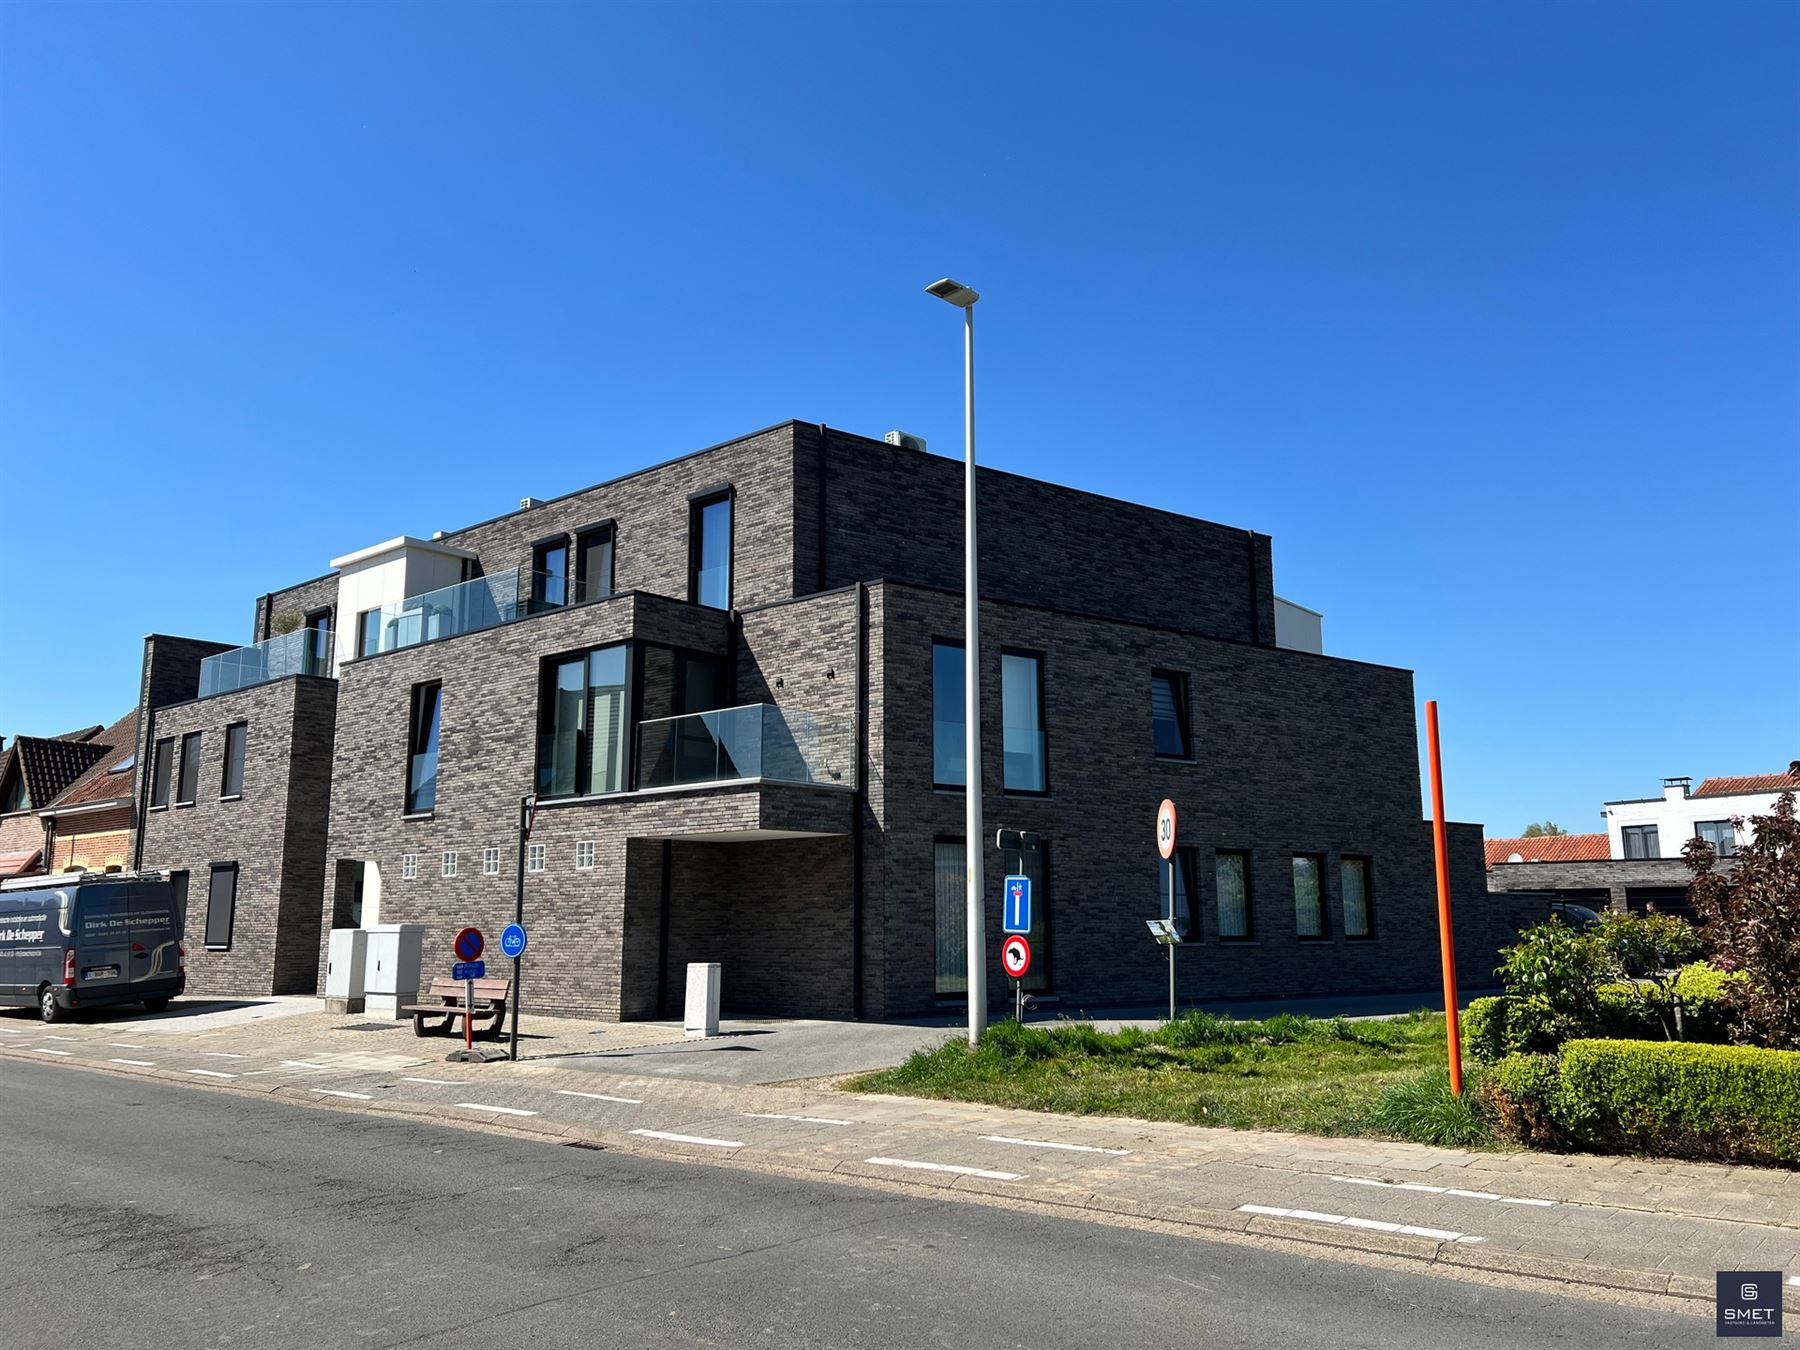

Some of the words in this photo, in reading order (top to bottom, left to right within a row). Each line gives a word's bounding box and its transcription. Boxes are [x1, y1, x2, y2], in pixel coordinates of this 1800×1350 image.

[1161, 818, 1171, 841] 30
[85, 920, 107, 929] Dirk
[125, 917, 170, 926] Schepper
[6, 929, 14, 941] De
[15, 928, 45, 943] Schepper
